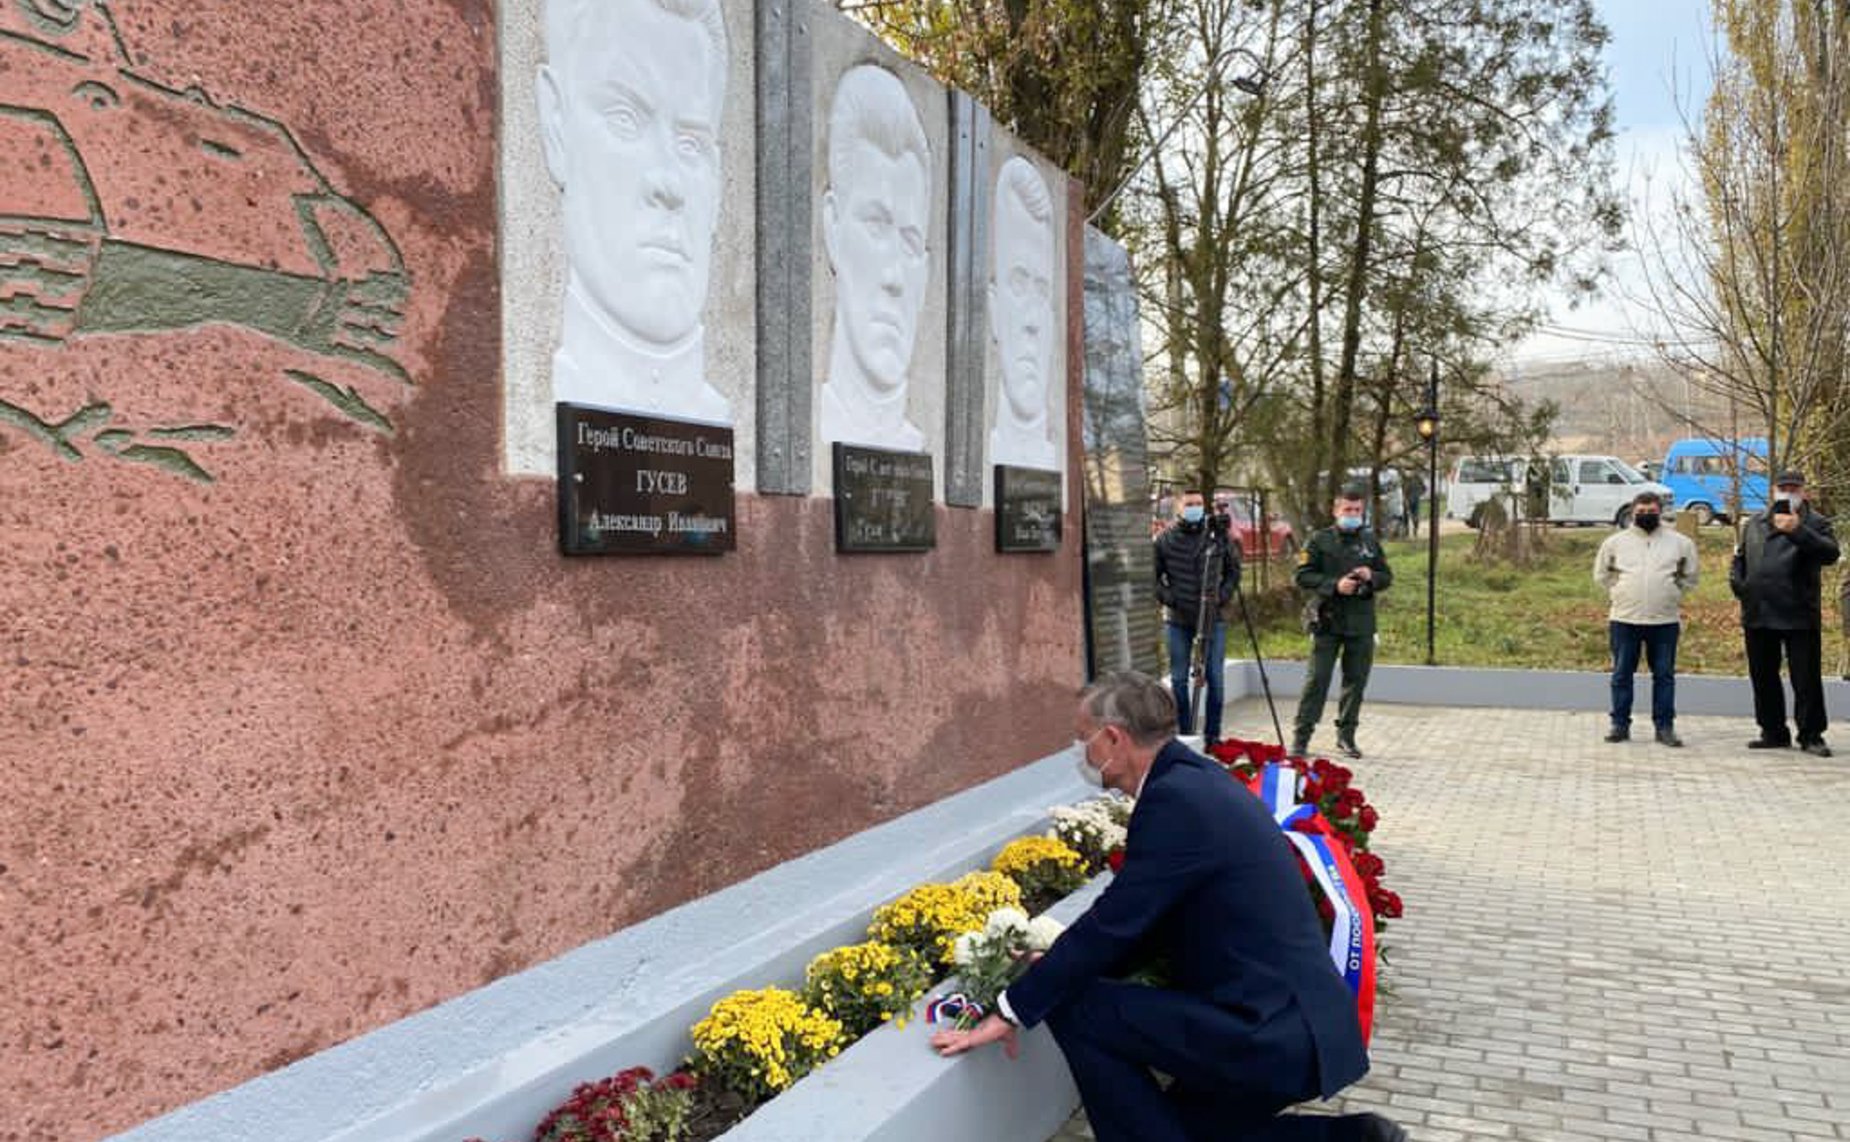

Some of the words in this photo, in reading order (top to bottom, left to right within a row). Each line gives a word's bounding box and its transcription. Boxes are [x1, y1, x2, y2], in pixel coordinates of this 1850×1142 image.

[578, 422, 618, 452] Герой
[623, 427, 694, 455] Советского
[636, 469, 687, 495] ГУСЕВ
